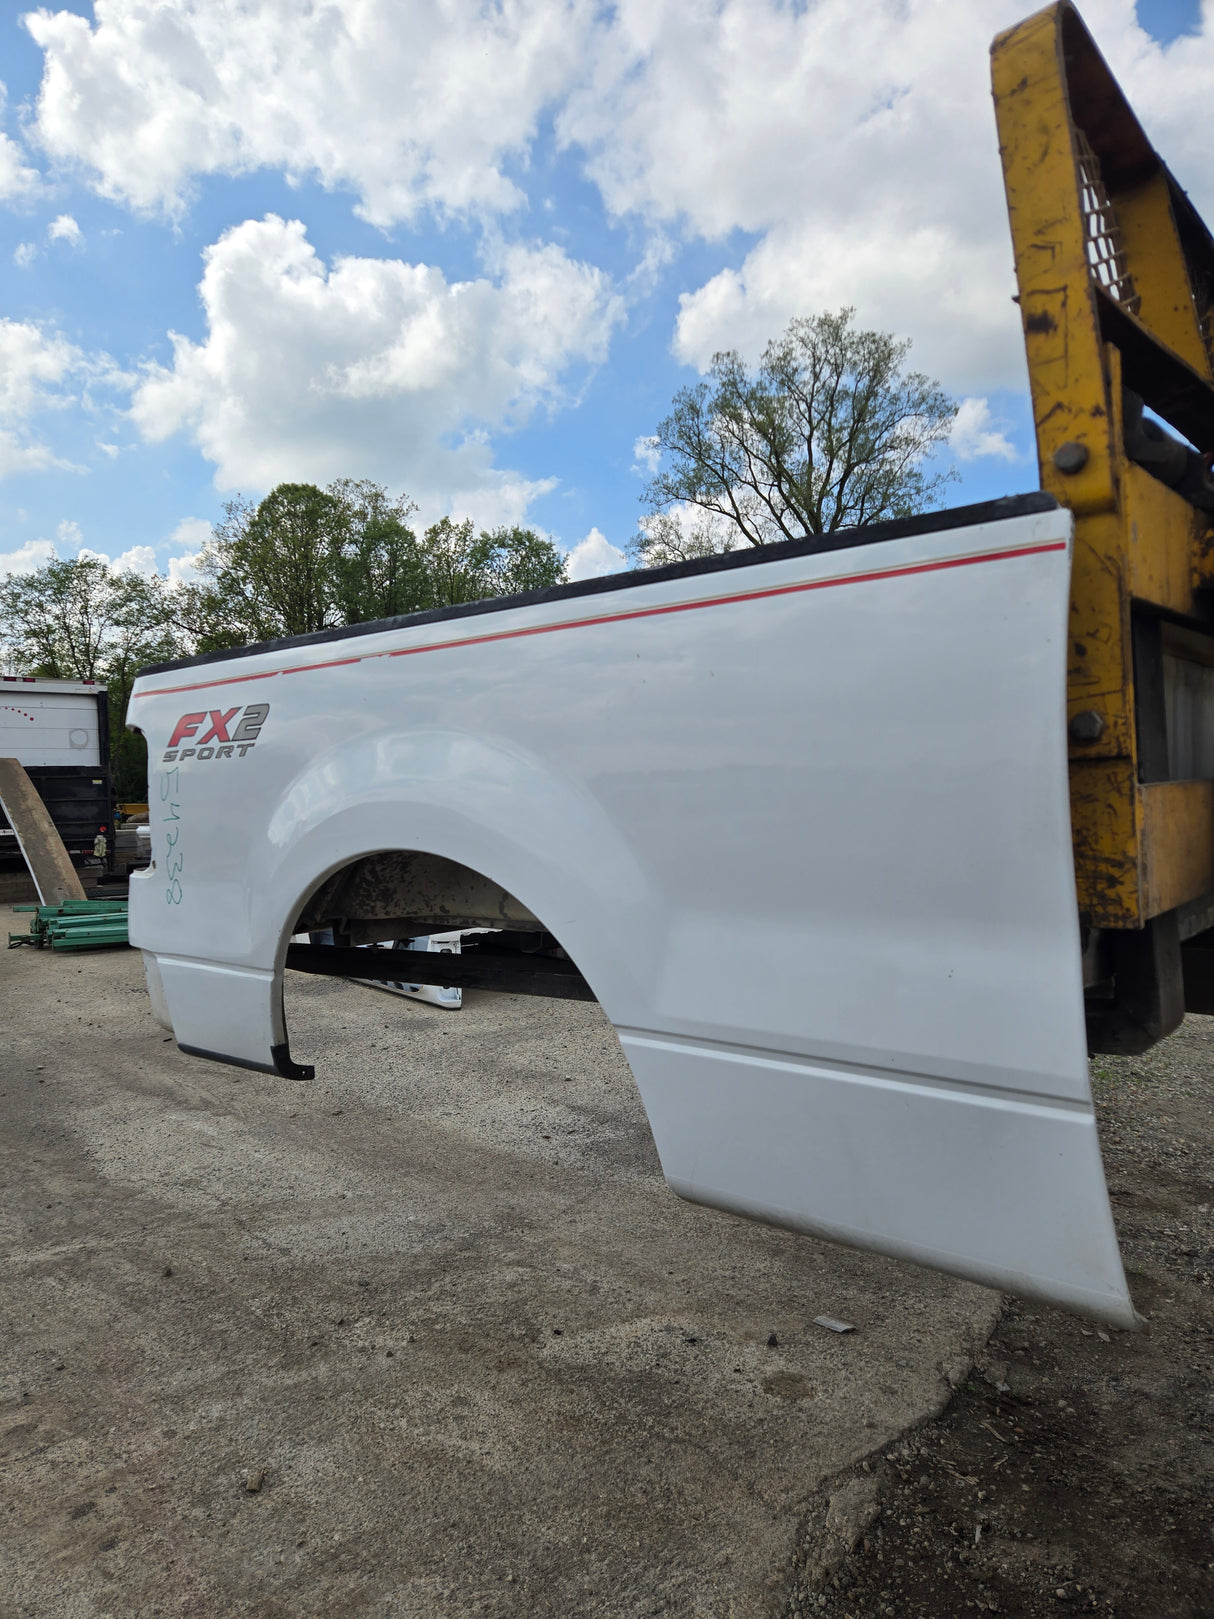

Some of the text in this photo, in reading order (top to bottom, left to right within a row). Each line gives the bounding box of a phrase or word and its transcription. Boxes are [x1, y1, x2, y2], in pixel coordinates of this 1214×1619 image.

[167, 703, 270, 748] FX2
[162, 742, 256, 763] SPORT
[160, 766, 183, 905] 54238
